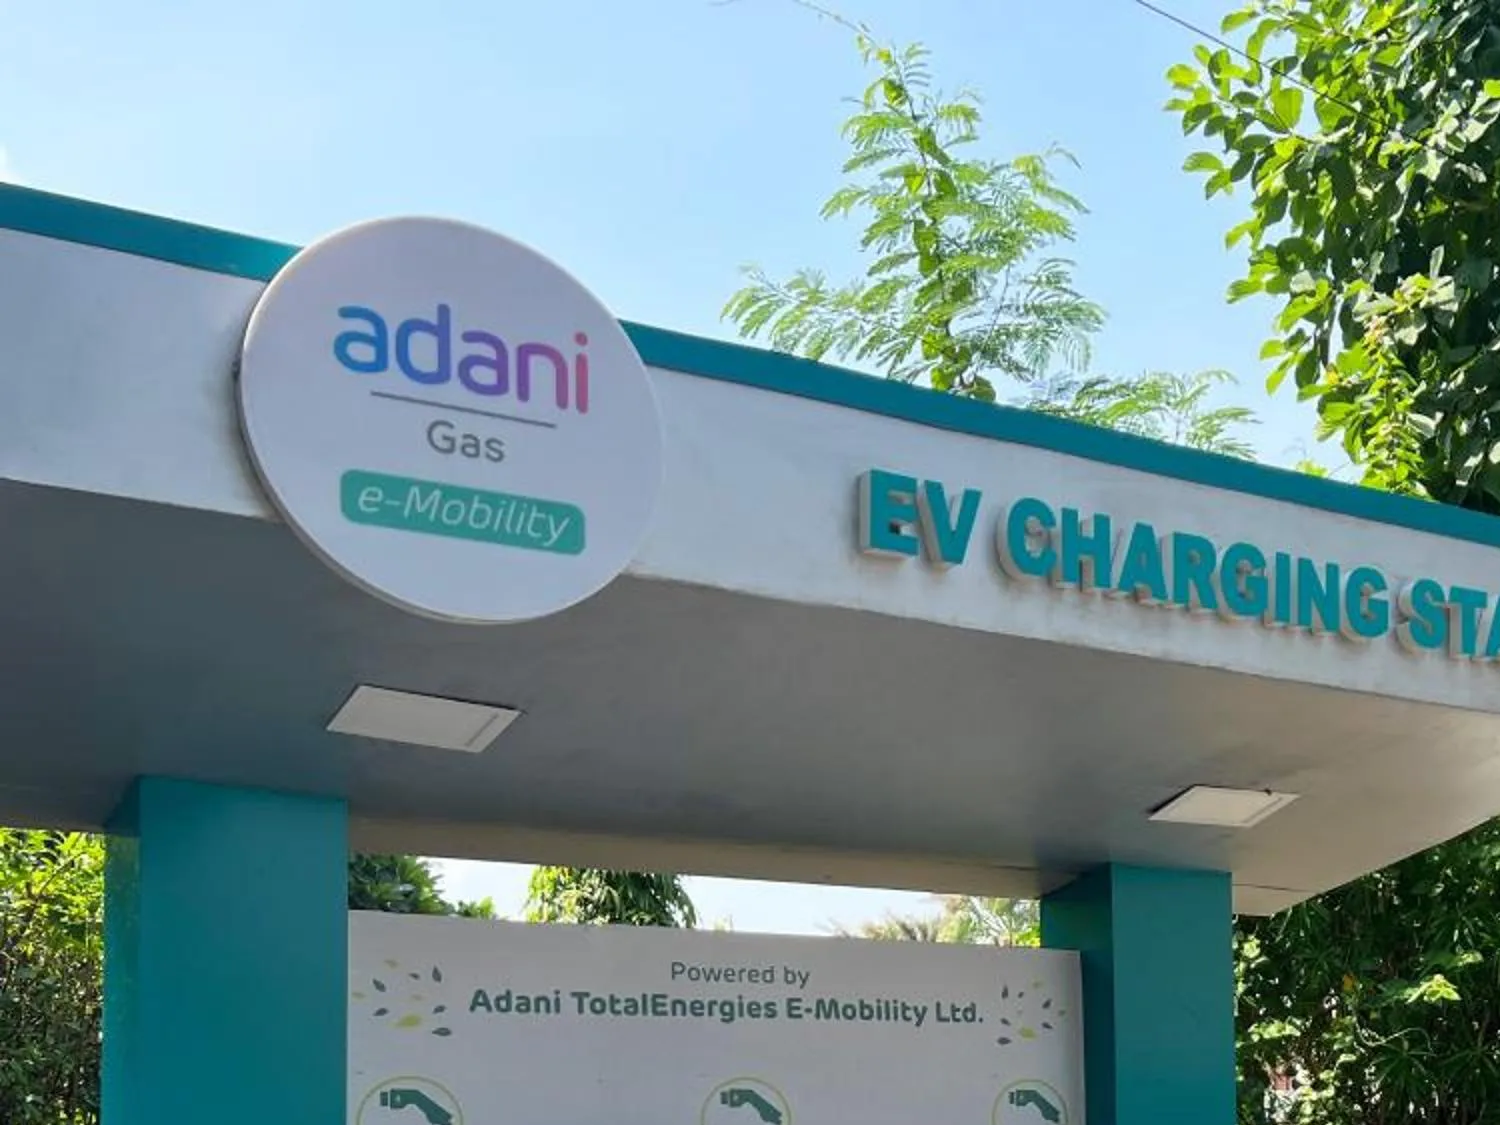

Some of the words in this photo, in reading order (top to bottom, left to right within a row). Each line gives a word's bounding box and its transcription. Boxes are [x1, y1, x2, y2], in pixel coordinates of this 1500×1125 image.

[333, 303, 590, 414] adani
[426, 419, 506, 463] Gas
[356, 484, 571, 546] e-Mobility
[867, 468, 983, 566] EV
[1005, 496, 1390, 639] CHARGING
[670, 960, 775, 984] Powered
[783, 965, 811, 990] by
[469, 988, 561, 1015] Adani
[569, 991, 778, 1025] TotalEnergies
[786, 997, 928, 1028] E-Mobility
[935, 1001, 985, 1024] Ltd.
